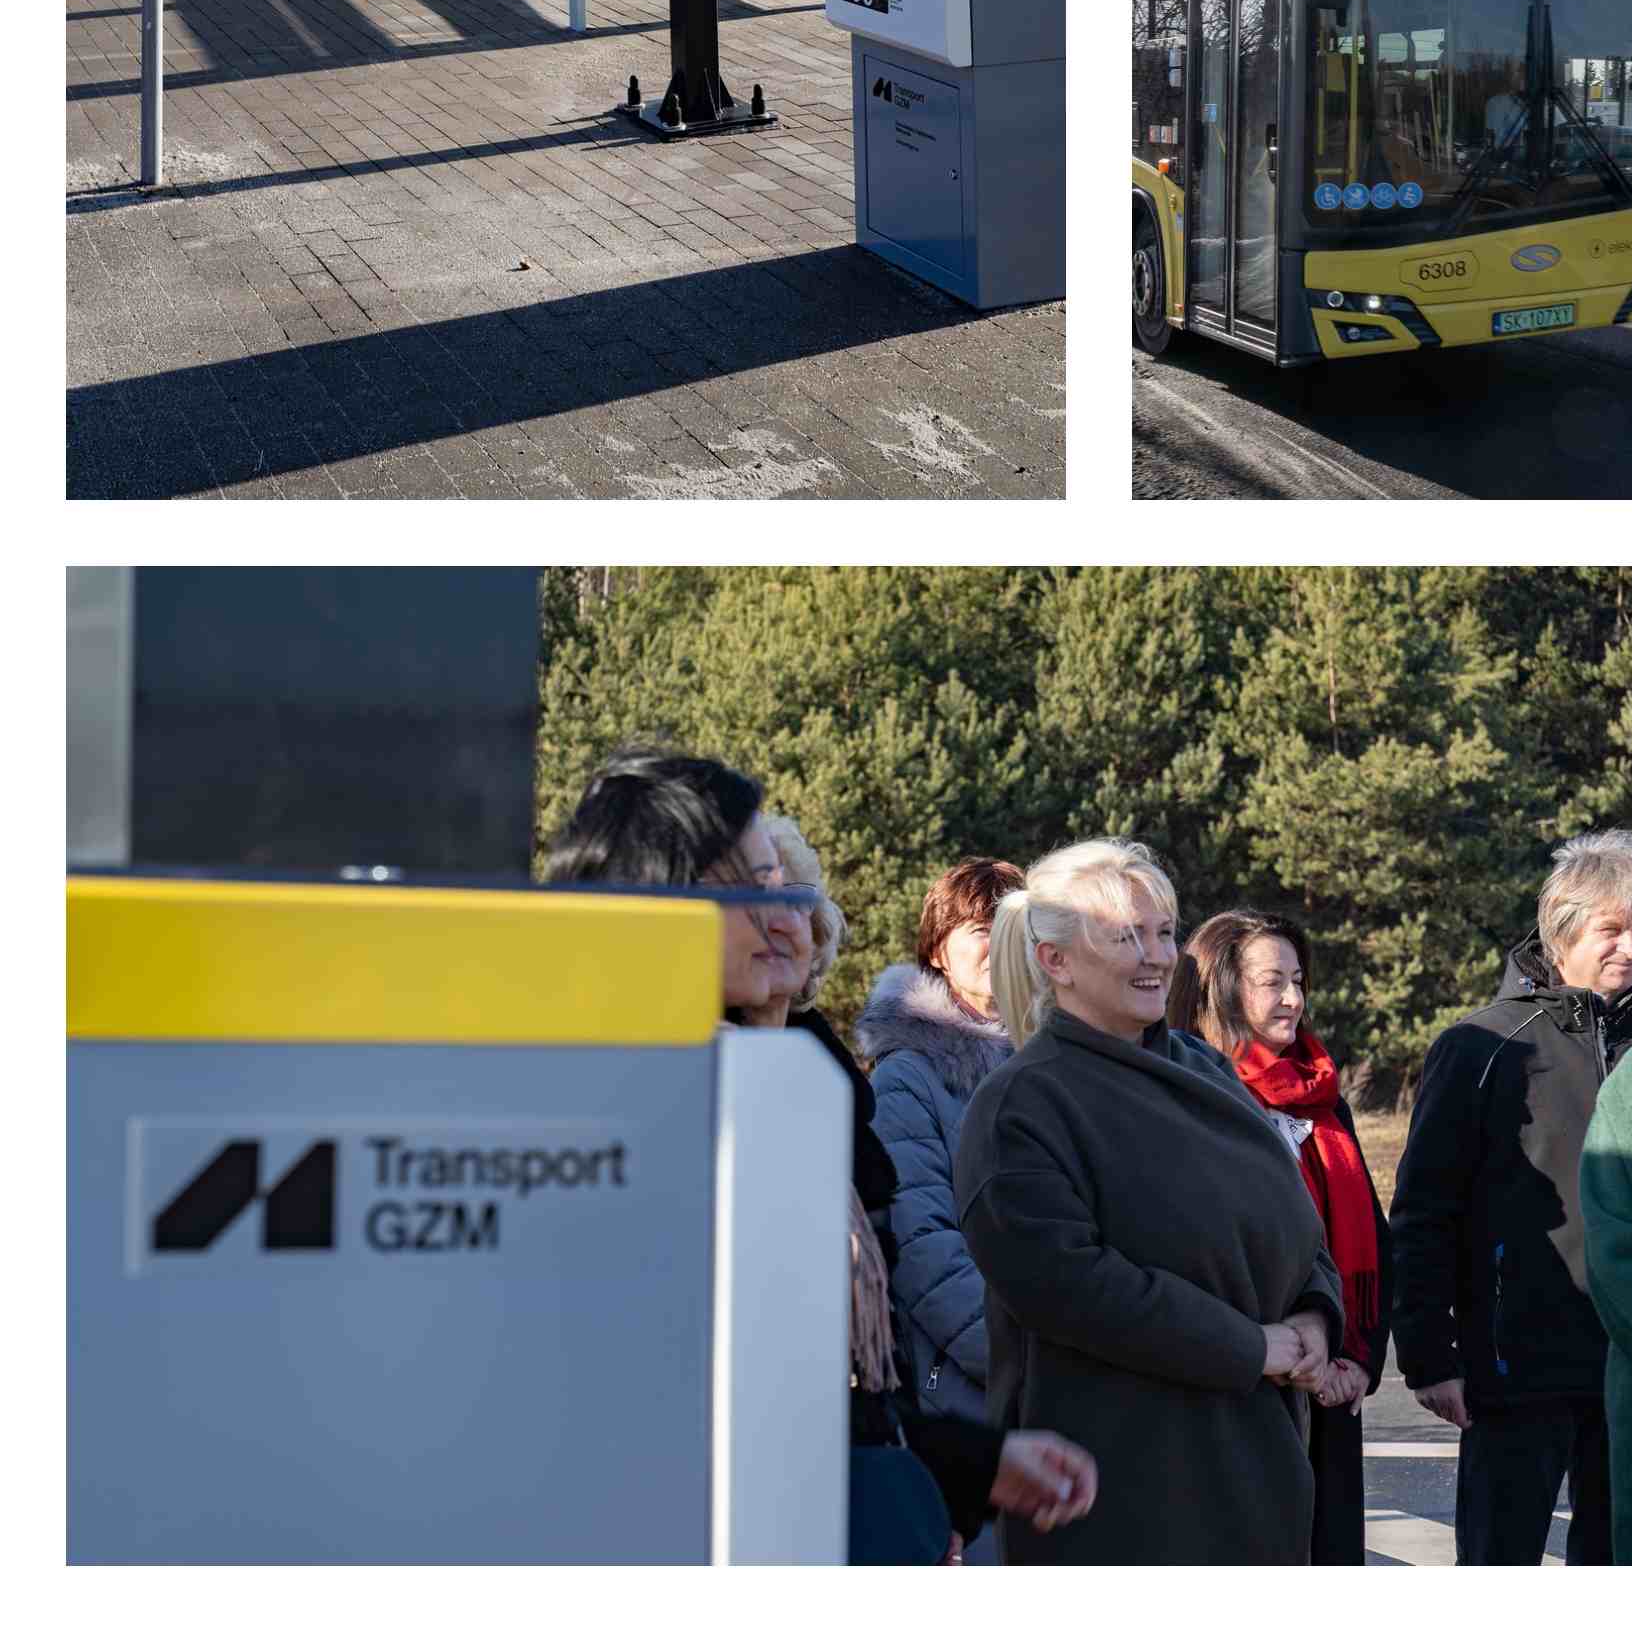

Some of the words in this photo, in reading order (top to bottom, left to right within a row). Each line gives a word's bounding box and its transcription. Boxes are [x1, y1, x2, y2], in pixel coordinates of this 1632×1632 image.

[1418, 260, 1467, 281] 6308
[365, 1136, 628, 1200] Transport
[365, 1200, 500, 1253] GZM
